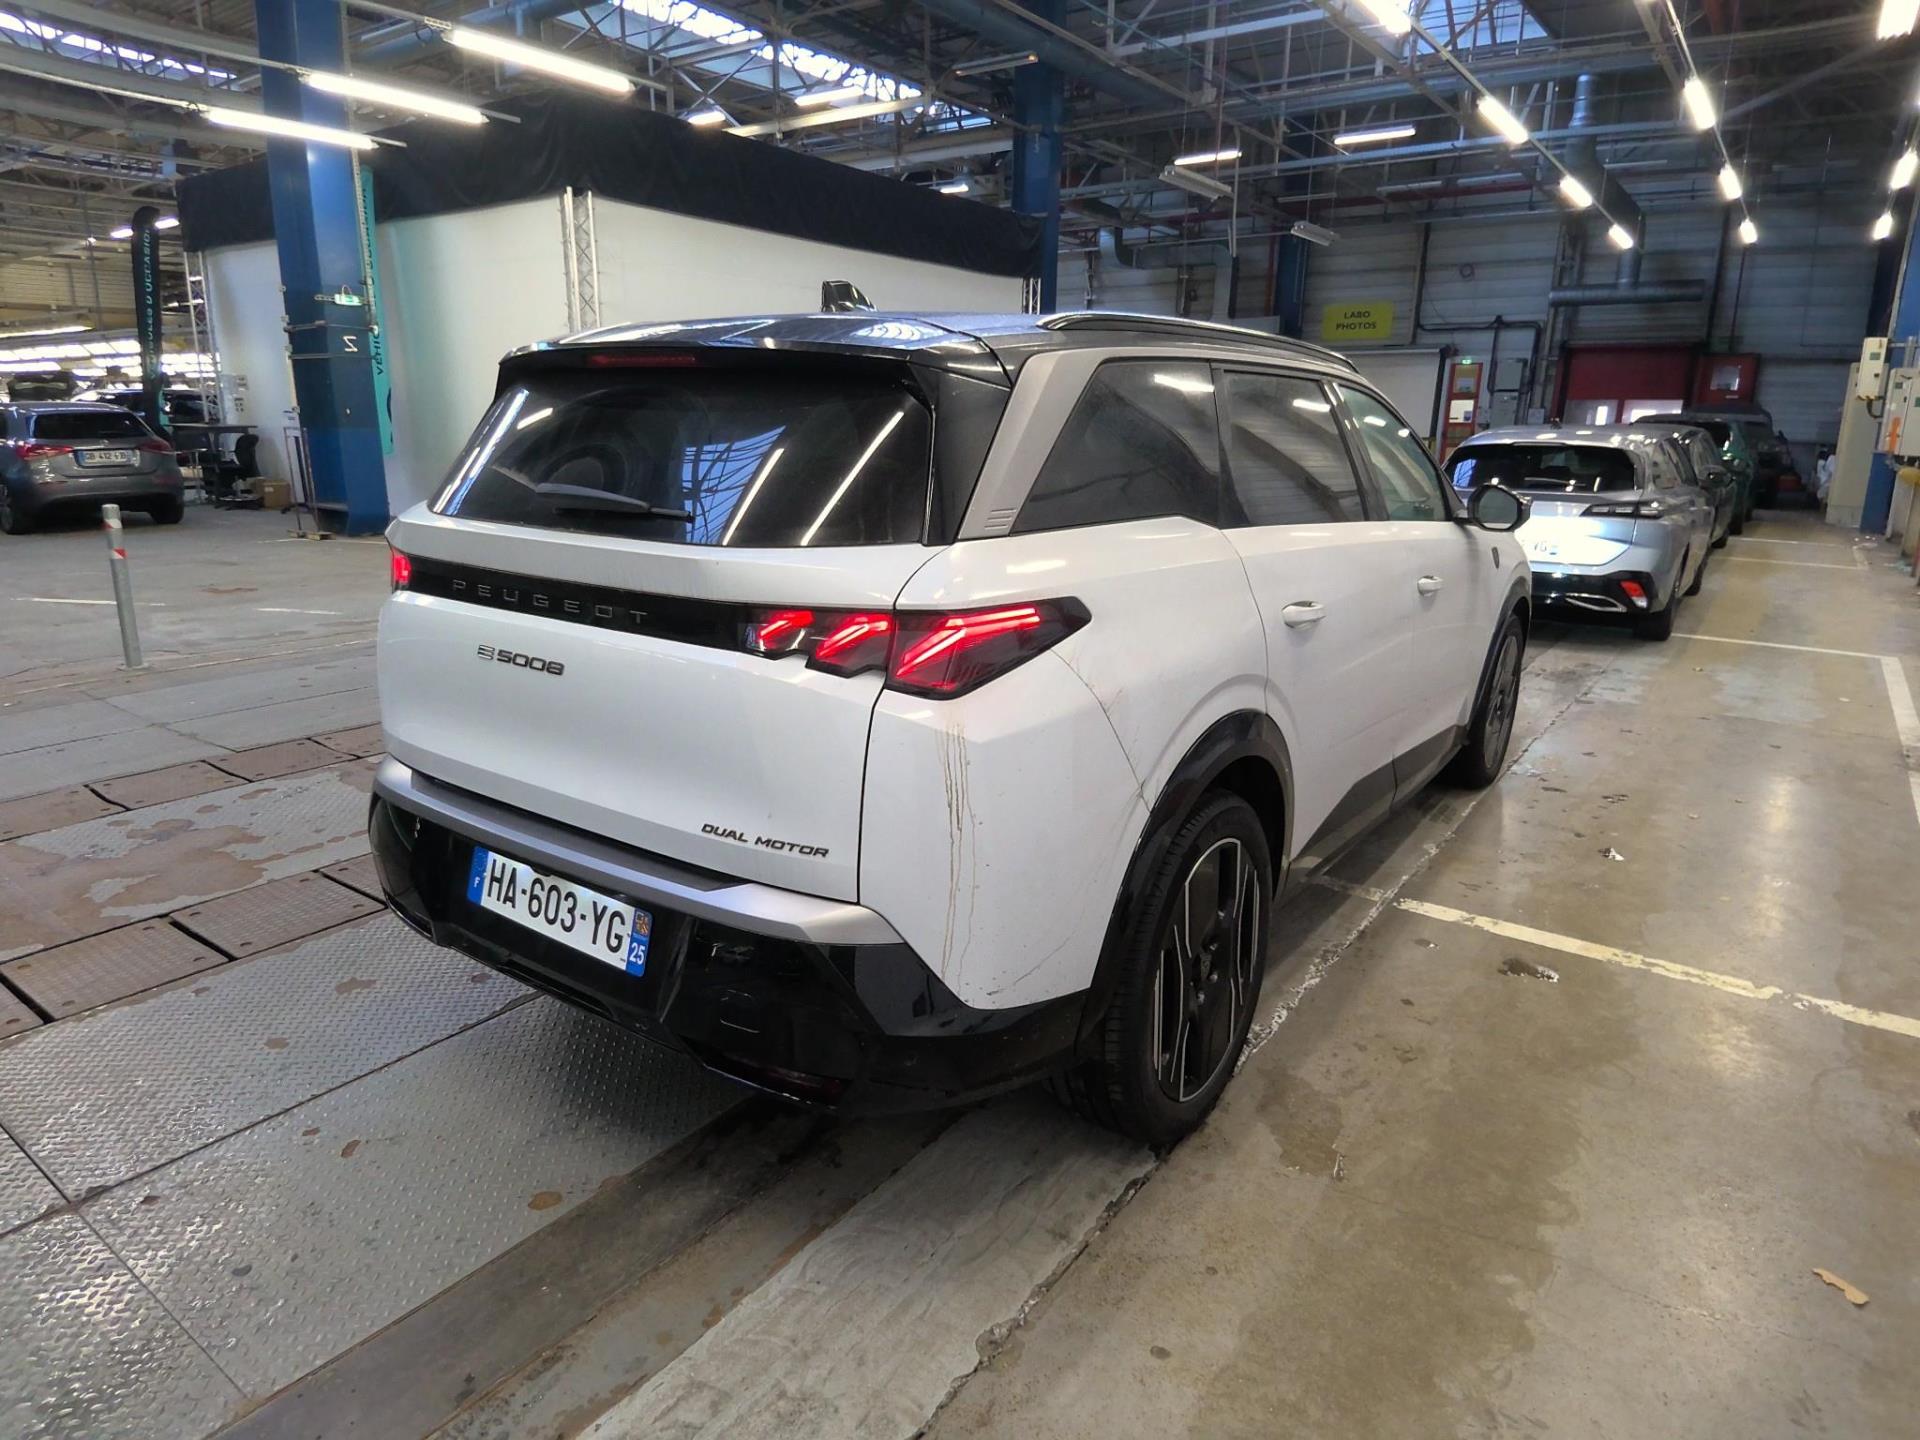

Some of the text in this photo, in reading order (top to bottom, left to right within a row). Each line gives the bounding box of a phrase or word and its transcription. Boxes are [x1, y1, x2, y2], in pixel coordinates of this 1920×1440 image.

[1335, 321, 1377, 331] PHOTOS
[1343, 310, 1371, 320] LABO
[453, 579, 648, 624] PEUGEOT
[701, 823, 830, 858] DUAL MOTOR
[473, 876, 481, 888] F
[487, 858, 626, 954] HA-603-YG
[629, 942, 646, 966] 25
